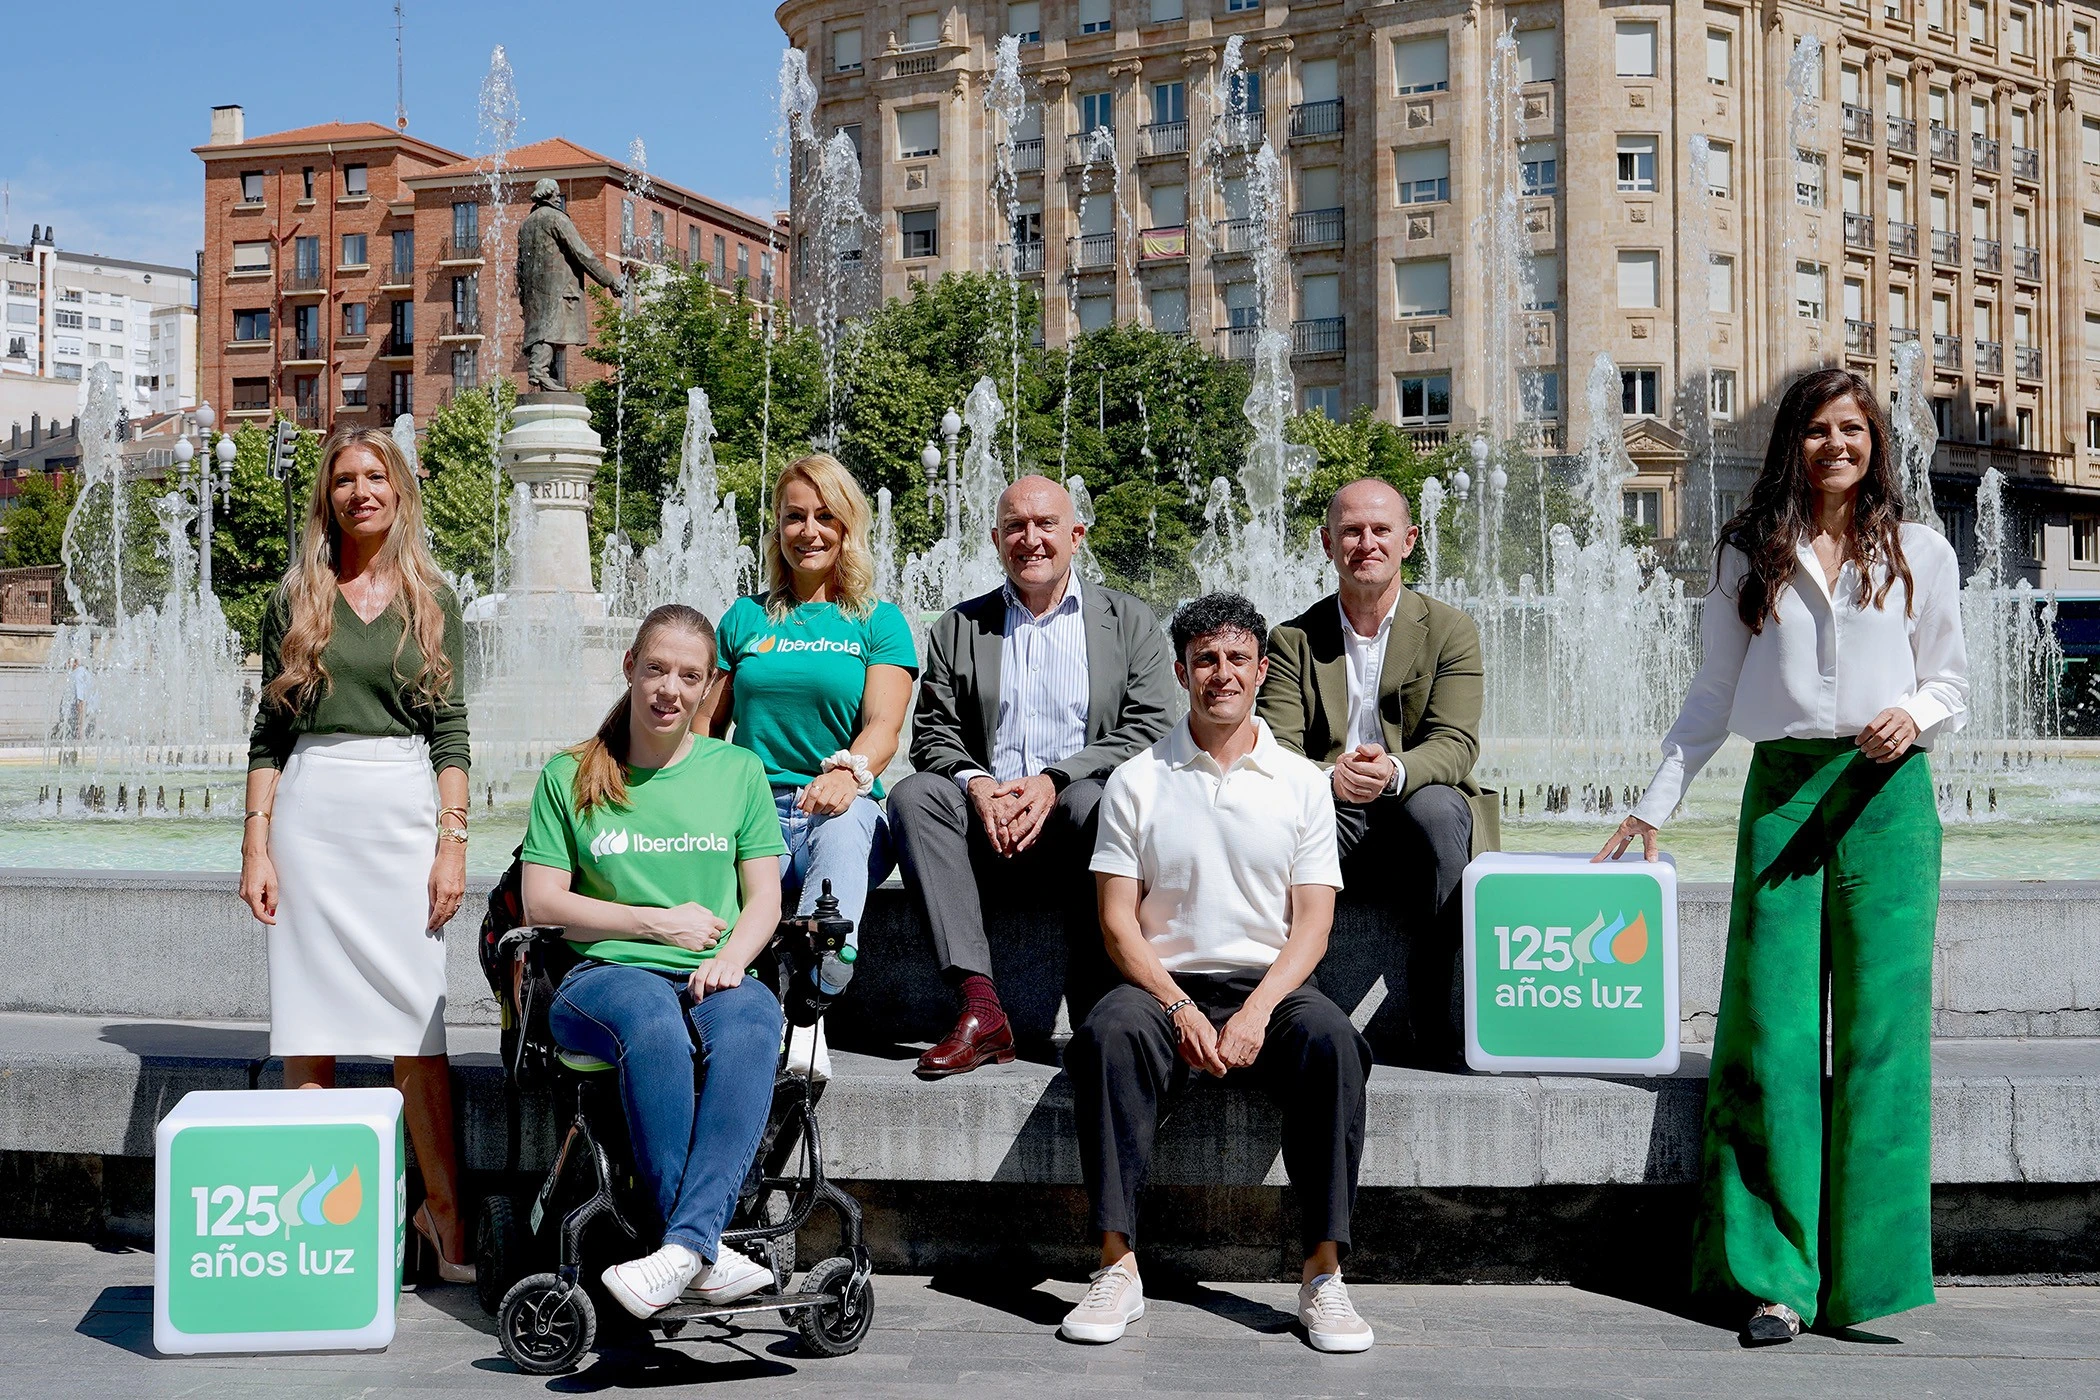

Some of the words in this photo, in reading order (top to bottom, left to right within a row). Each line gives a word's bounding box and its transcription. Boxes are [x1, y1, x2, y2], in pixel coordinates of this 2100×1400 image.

[777, 637, 861, 656] Iberdrola
[633, 832, 728, 852] Iberdrola
[1494, 925, 1574, 972] 125
[1495, 976, 1582, 1008] años
[1592, 978, 1643, 1009] luz
[191, 1185, 280, 1237] 125
[190, 1243, 288, 1278] años
[299, 1242, 355, 1275] luz
